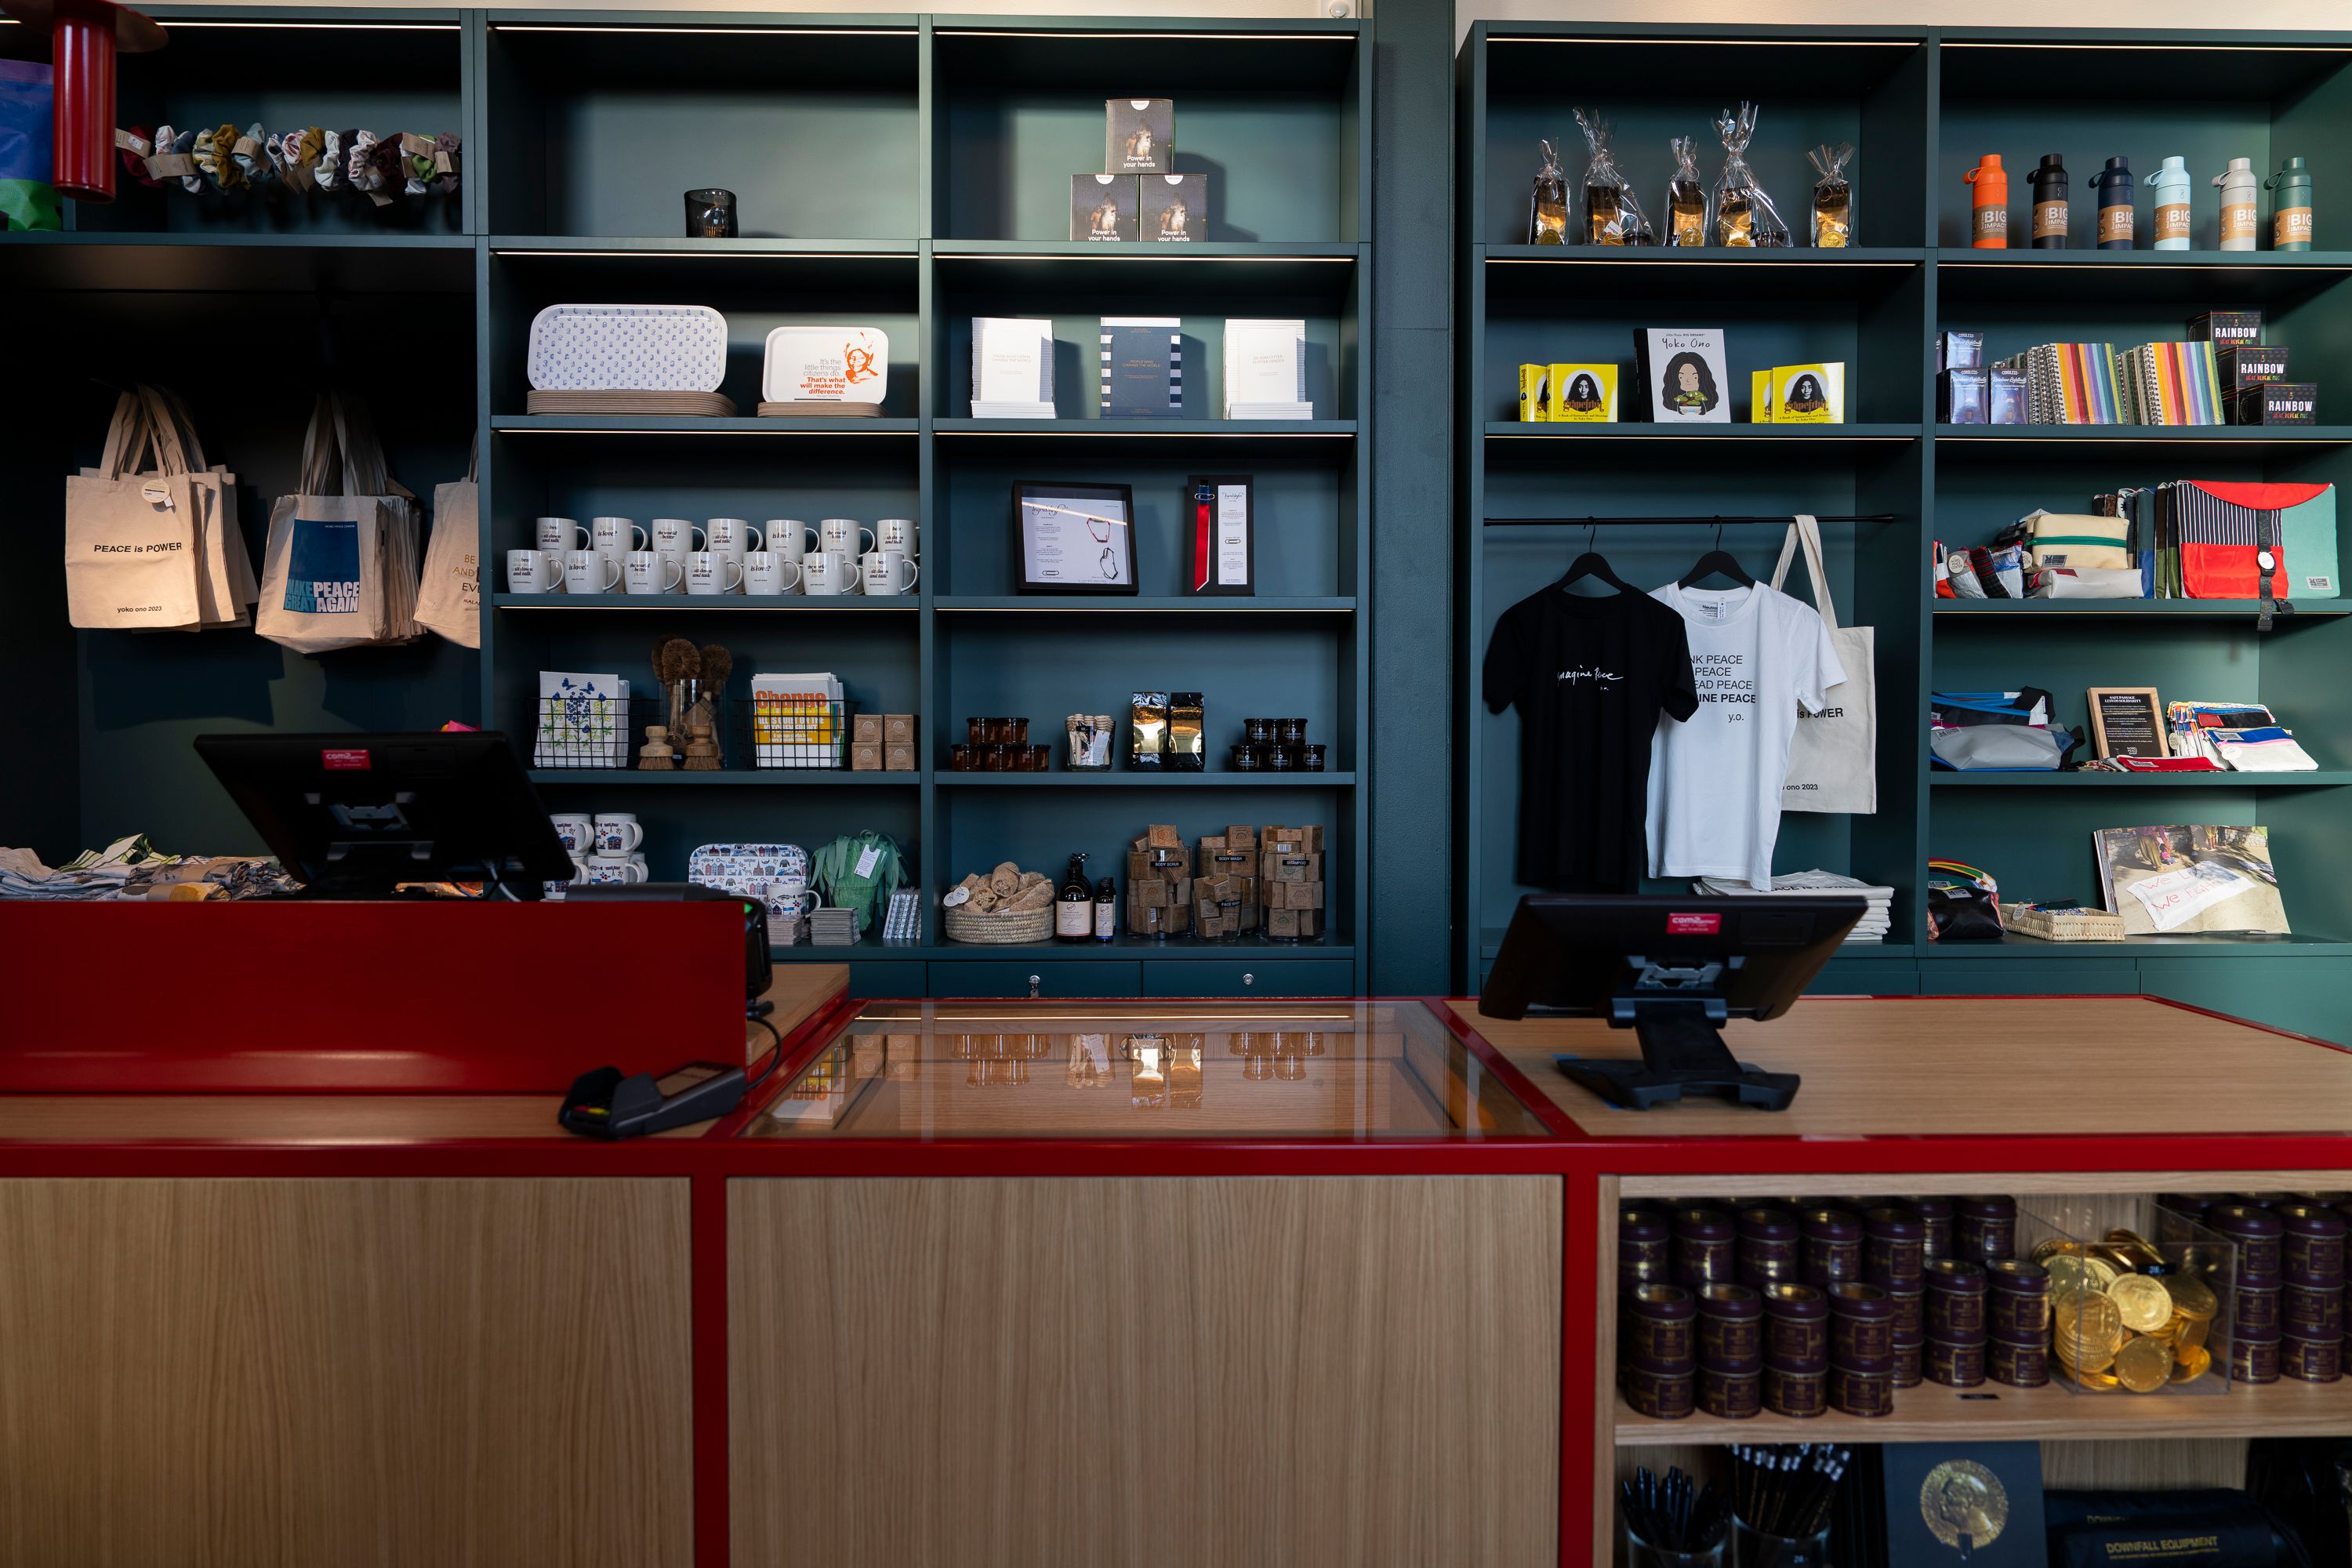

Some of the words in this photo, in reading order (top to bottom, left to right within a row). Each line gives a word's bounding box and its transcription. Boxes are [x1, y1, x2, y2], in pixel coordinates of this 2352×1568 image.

[1984, 210, 2006, 223] BIG
[2169, 209, 2190, 222] BIG
[2237, 209, 2256, 221] BIG
[2290, 213, 2312, 226] BIG
[2215, 328, 2257, 338] RAINBOW
[1662, 338, 1686, 350] Yoko
[1690, 338, 1711, 348] Ono
[2241, 364, 2285, 374] RAINBOW
[1563, 398, 1604, 415] grapefruit
[2268, 401, 2313, 412] RAINBOW
[94, 544, 132, 553] PEACE
[146, 542, 182, 553] POWER
[464, 554, 476, 564] BE
[452, 566, 475, 577] AND
[286, 579, 313, 597] MAKE
[314, 581, 360, 598] PEACE
[284, 594, 317, 612] GREAT
[316, 597, 358, 613] AGAIN
[1690, 655, 1704, 664] NK
[1706, 655, 1744, 664] PEACE
[1695, 667, 1732, 677] PEACE
[1717, 681, 1753, 690] PEACE
[755, 690, 827, 709] Change
[1698, 694, 1718, 702] INE
[1720, 694, 1756, 703] PEACE
[1728, 713, 1744, 723] y.o.
[1797, 710, 1805, 719] is
[2151, 894, 2180, 909] We
[2105, 1540, 2159, 1554] DOWNFALL
[2160, 1536, 2219, 1551] EQUIPMENT
